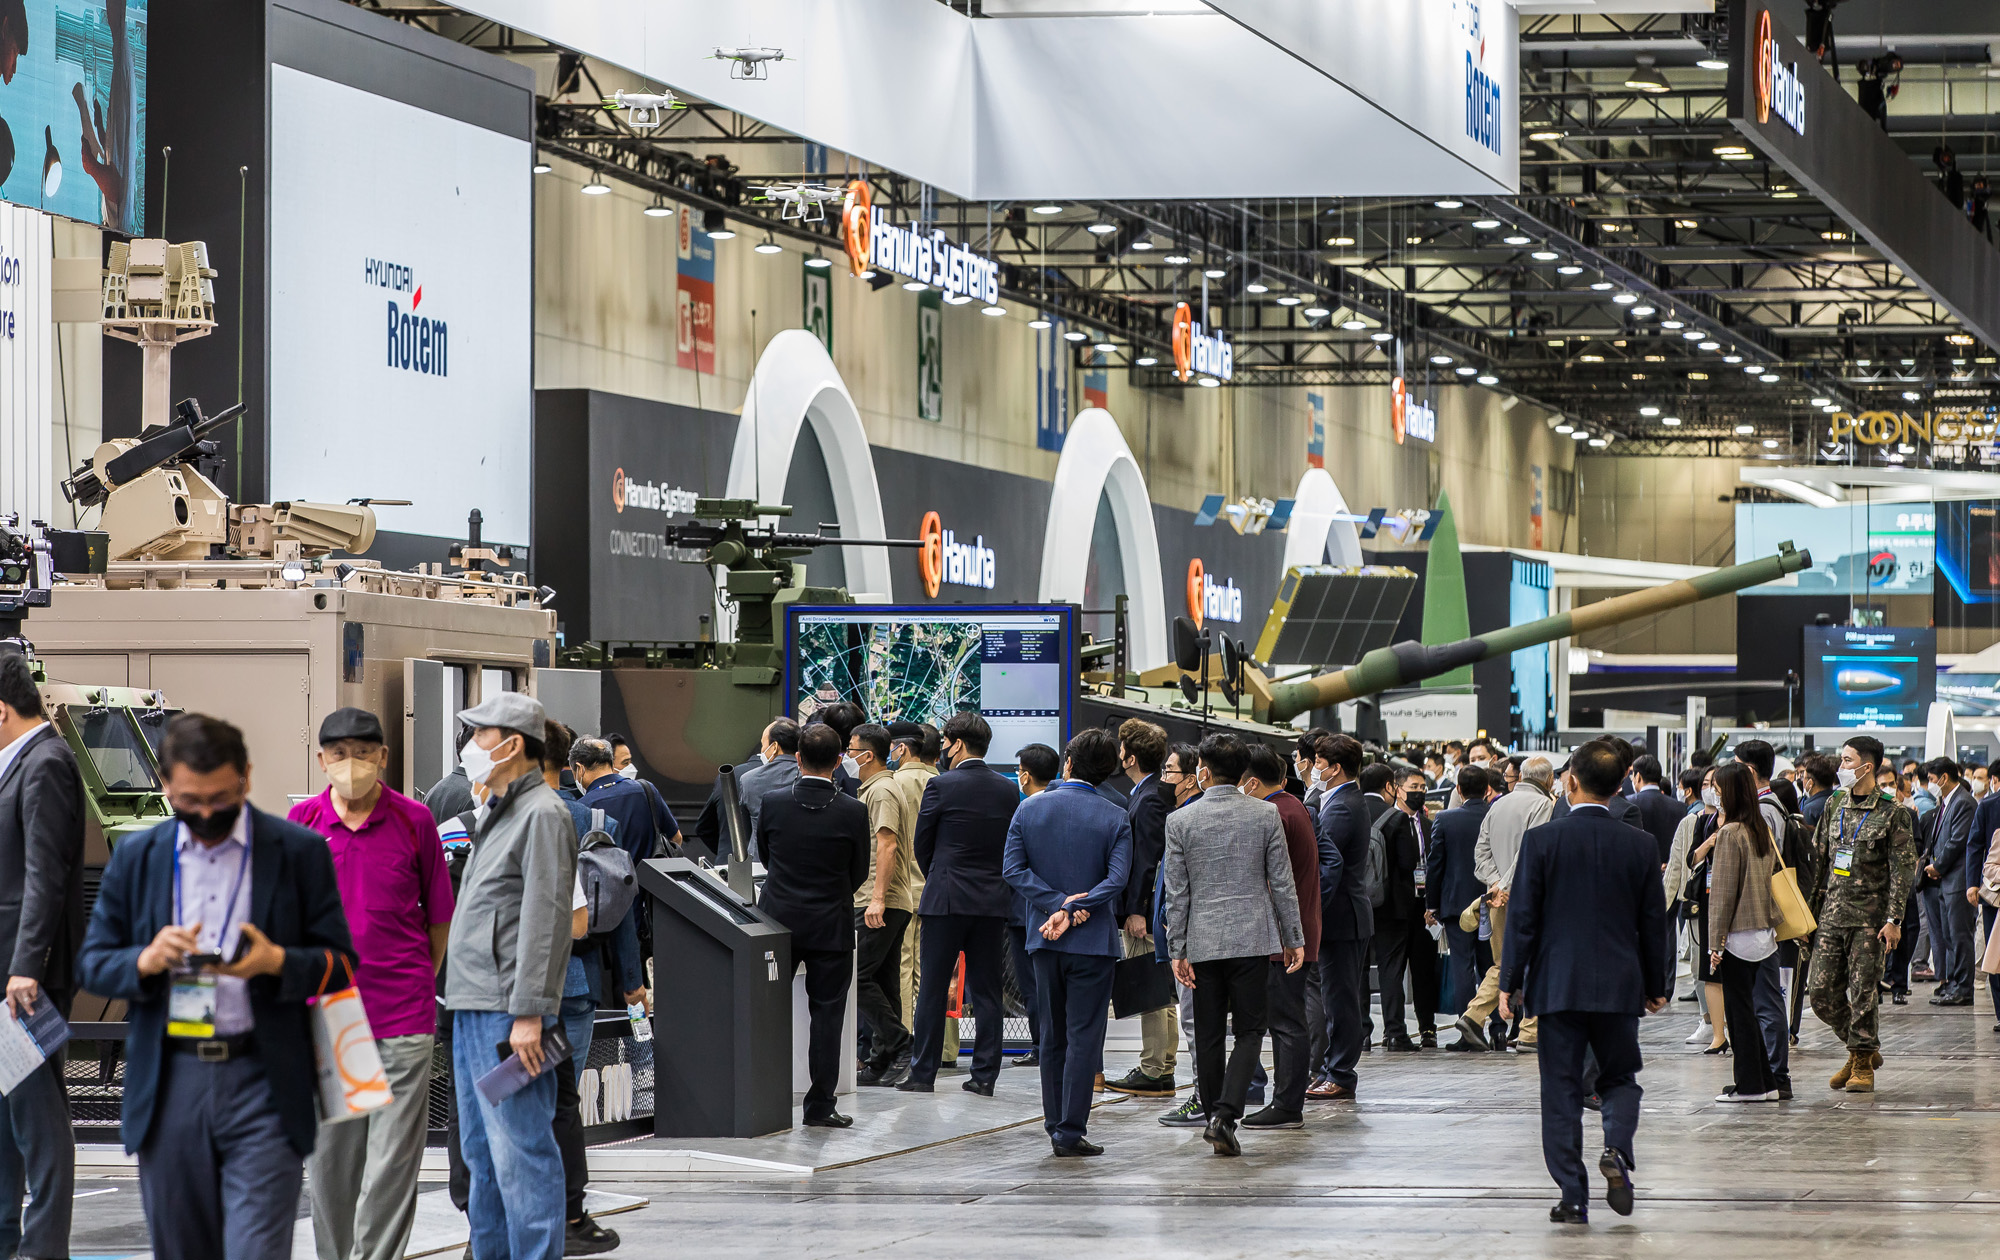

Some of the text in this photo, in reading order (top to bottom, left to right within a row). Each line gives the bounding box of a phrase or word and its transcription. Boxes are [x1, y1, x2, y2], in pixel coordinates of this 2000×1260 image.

[1466, 49, 1501, 157] Rotem
[1771, 39, 1805, 136] Hanwha
[365, 257, 413, 293] HYUNDAI
[870, 205, 998, 305] Hanwha Systems
[388, 300, 447, 377] Rotem
[1191, 321, 1232, 380] Hanwha
[1405, 392, 1435, 442] Hanwha
[624, 477, 698, 518] Hanwha Systems
[610, 530, 645, 556] CONNECT
[942, 529, 995, 589] Hanwha
[1204, 573, 1242, 623] Hanwha
[1381, 708, 1458, 718] anwha Systems
